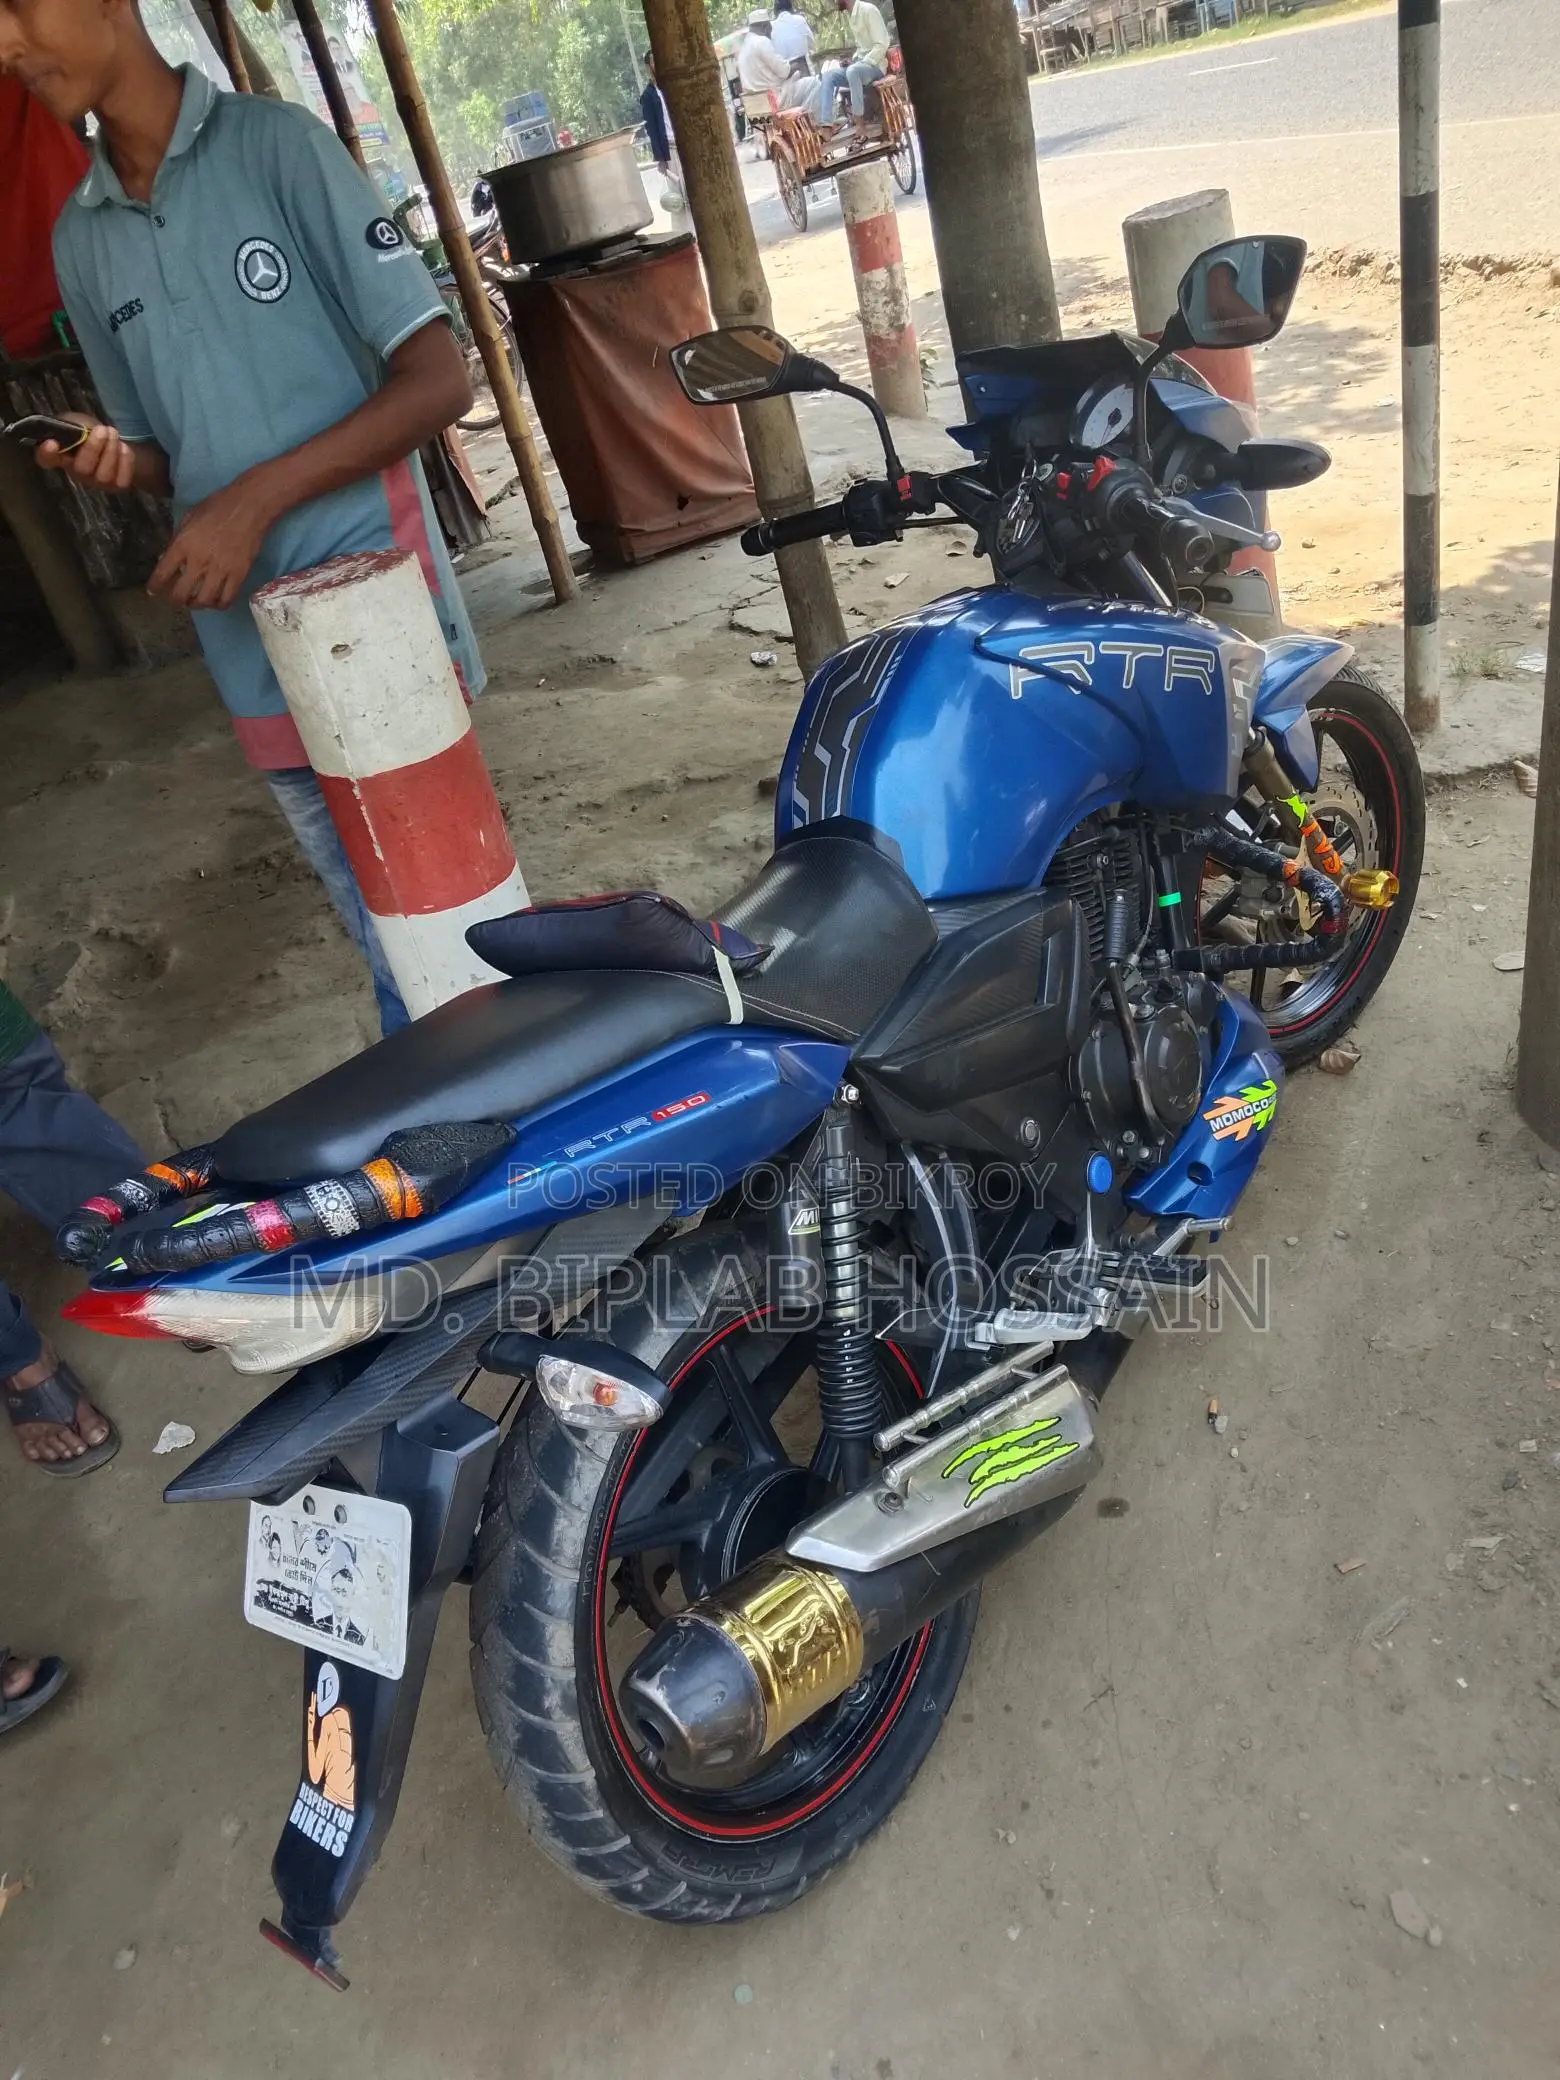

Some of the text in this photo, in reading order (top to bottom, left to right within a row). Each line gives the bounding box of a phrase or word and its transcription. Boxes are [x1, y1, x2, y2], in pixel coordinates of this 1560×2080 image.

[1009, 641, 1215, 700] RTR
[564, 1095, 706, 1158] RTR 150
[290, 1798, 348, 1857] BIKERS
[299, 1782, 354, 1833] RESPECT FOR
